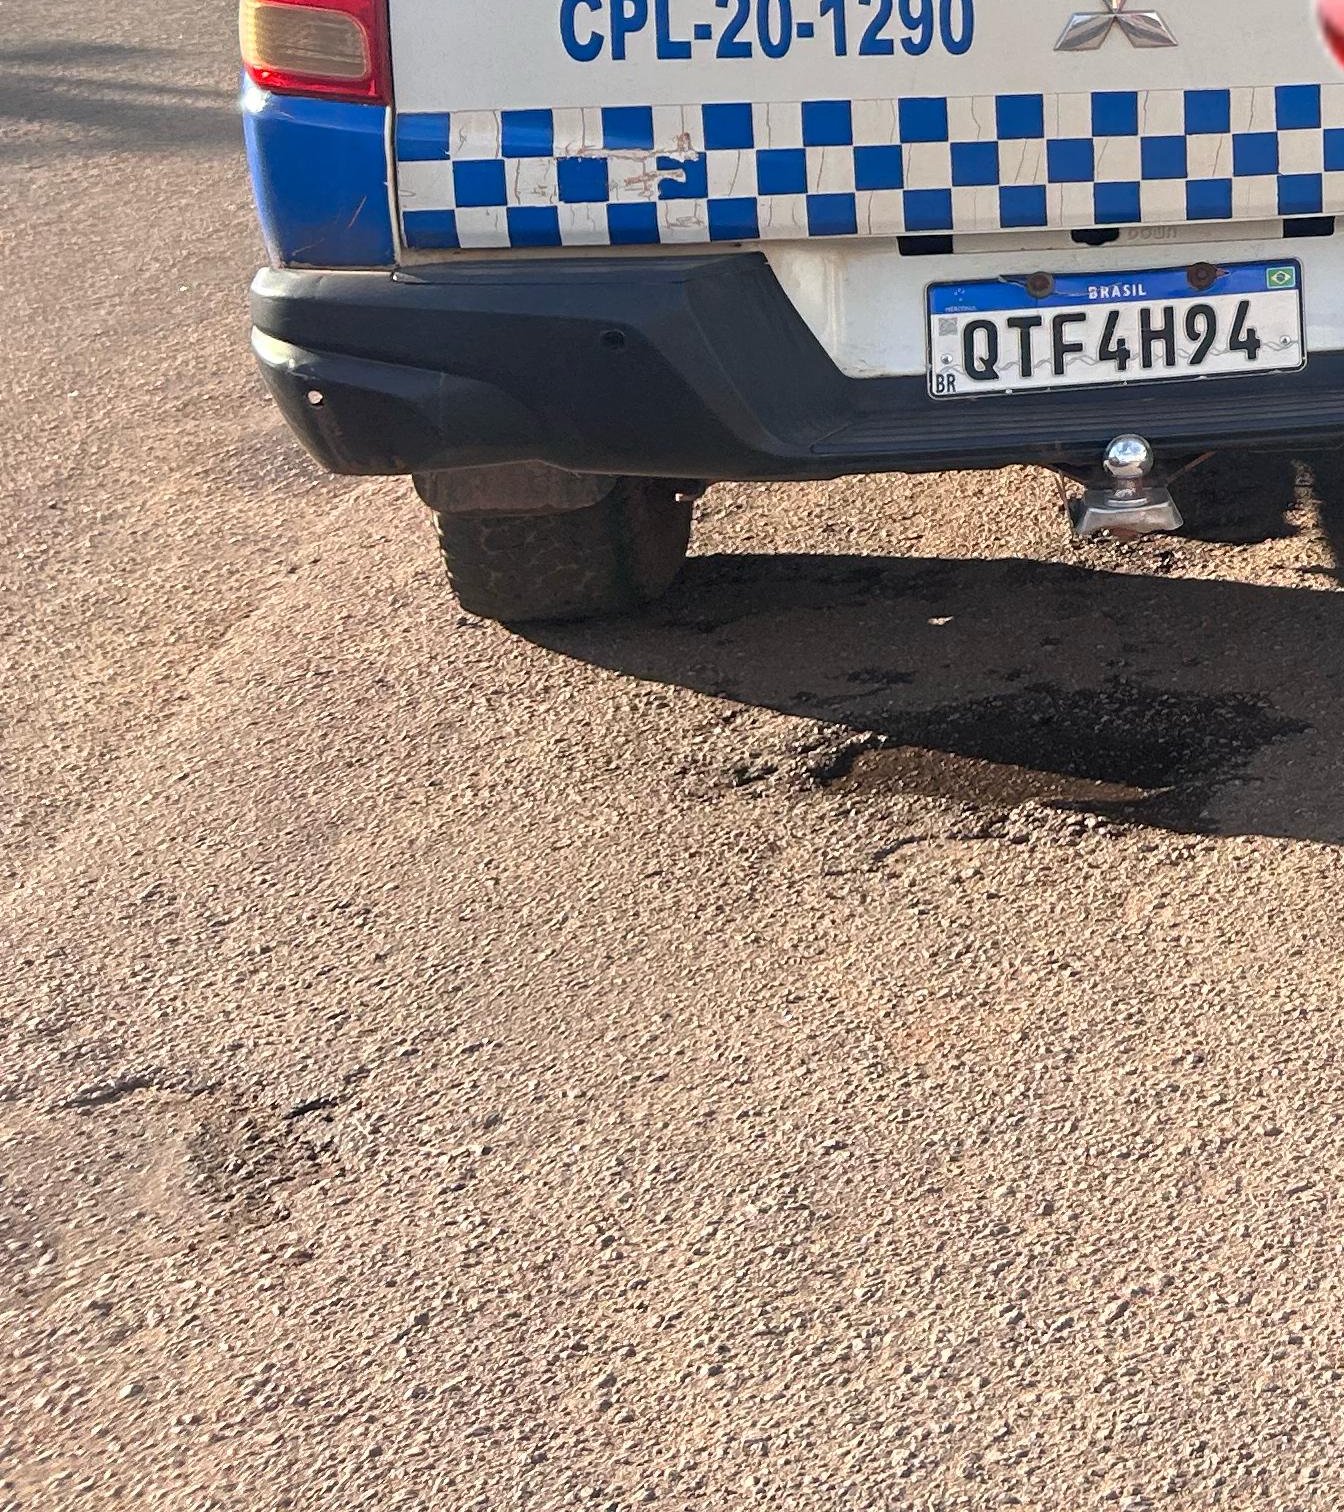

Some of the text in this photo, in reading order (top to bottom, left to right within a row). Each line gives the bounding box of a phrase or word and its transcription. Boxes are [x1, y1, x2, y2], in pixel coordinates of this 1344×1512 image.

[1087, 283, 1147, 300] BRASIL
[961, 299, 1261, 381] QTF4H94
[936, 373, 956, 394] BR
